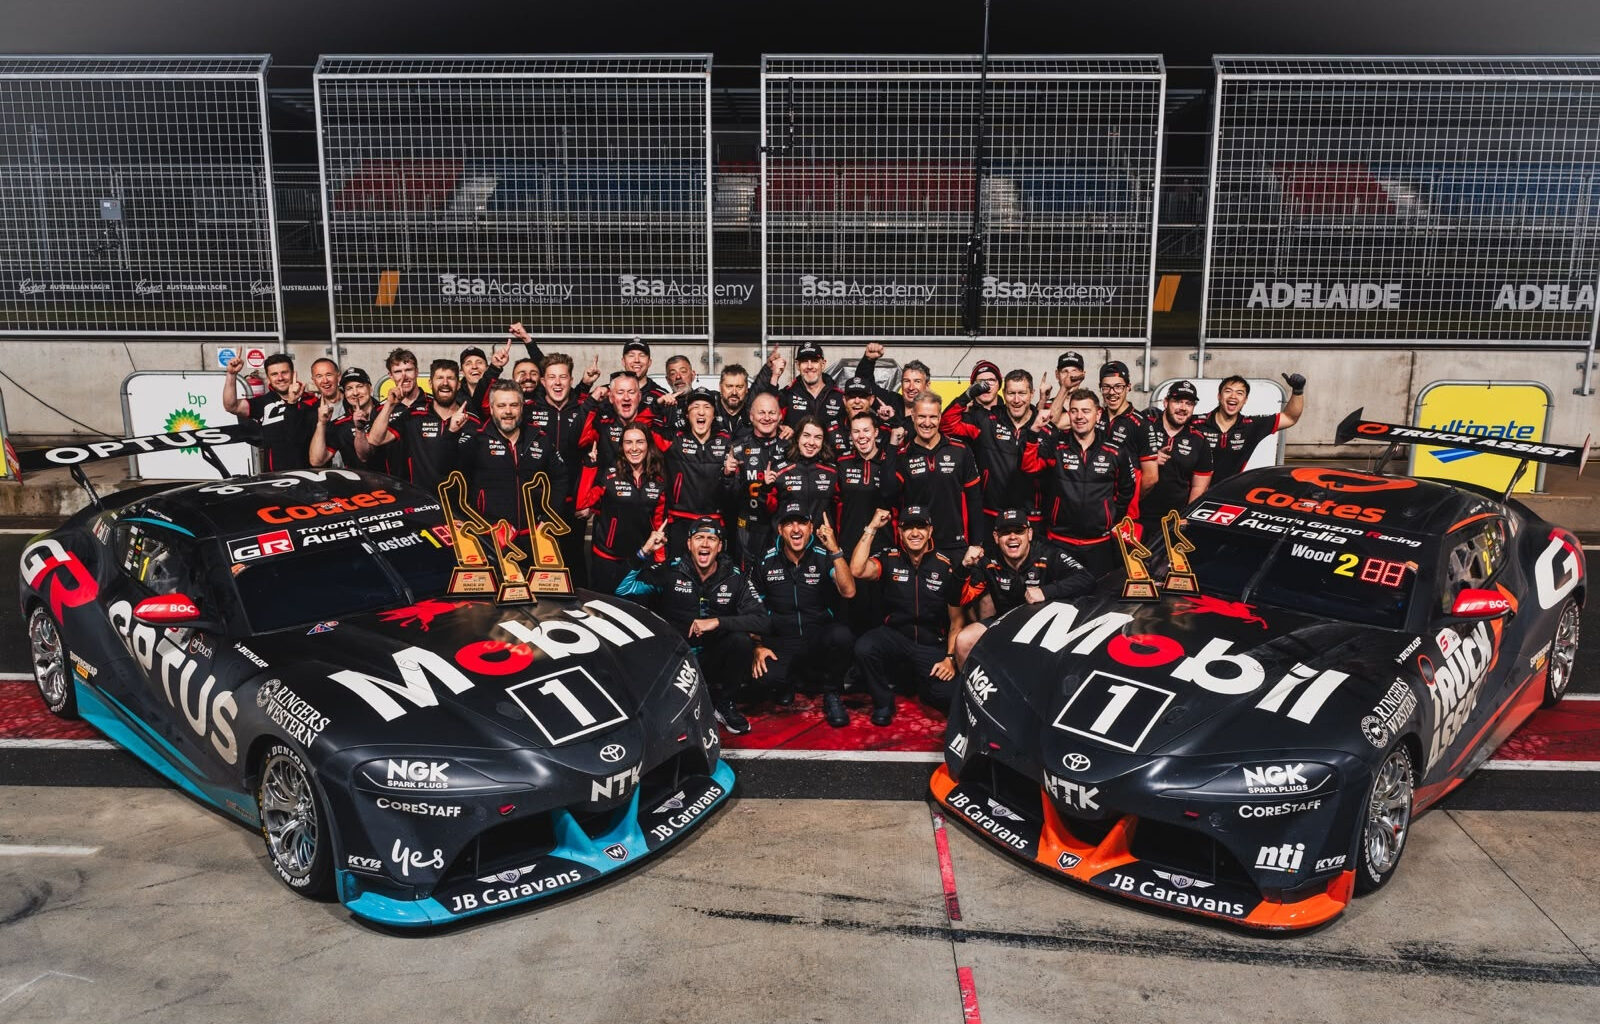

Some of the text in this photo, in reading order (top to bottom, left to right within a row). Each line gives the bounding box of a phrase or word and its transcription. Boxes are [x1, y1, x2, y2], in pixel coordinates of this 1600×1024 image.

[441, 274, 574, 300] asa Academy
[620, 275, 665, 296] asa
[801, 275, 937, 302] asa Academy
[982, 277, 1118, 303] asa Academy
[1247, 283, 1401, 310] ADELAIDE
[187, 392, 207, 407] bp
[45, 429, 231, 464] OPTUS
[1390, 427, 1575, 458] TRUCK ASSIST
[256, 489, 396, 524] Coates
[296, 503, 441, 535] TOYOTA GAZOO Racing
[1191, 508, 1235, 524] GR
[1245, 487, 1387, 523] Coates
[233, 536, 294, 562] GR
[420, 530, 443, 549] 1
[1307, 521, 1364, 536] GAZOO
[1365, 531, 1422, 548] Racing
[1291, 543, 1359, 578] Wood 2
[1360, 558, 1406, 588] 88
[20, 539, 99, 627] GR
[169, 603, 196, 613] BOC
[1489, 599, 1510, 609] BOC
[238, 646, 269, 669] DUNLOP
[327, 599, 656, 722] Mobil
[1011, 601, 1350, 724] Mobil
[1400, 636, 1422, 662] DUNLOP
[673, 659, 697, 694] NGK
[969, 665, 998, 701] NGK
[274, 686, 331, 732] RINGERS
[538, 678, 597, 728] 1
[1090, 684, 1139, 735] 1
[1372, 677, 1410, 722] RINGERS
[266, 698, 318, 748] WESTERN
[272, 745, 307, 773] DUNLOP
[387, 759, 450, 782] NGK
[387, 780, 416, 789] SPARK
[590, 761, 643, 802] NTK
[1043, 768, 1101, 811] NTK
[1242, 763, 1308, 787] NGK
[1248, 784, 1309, 794] SPARK PLUGS
[651, 784, 722, 842] JB Caravans
[948, 791, 1029, 850] JB Caravans
[348, 854, 382, 868] KYB
[1255, 843, 1306, 869] nti
[1315, 855, 1347, 870] KYB
[452, 869, 582, 912] JB Caravans
[1109, 873, 1244, 916] JB Caravans
